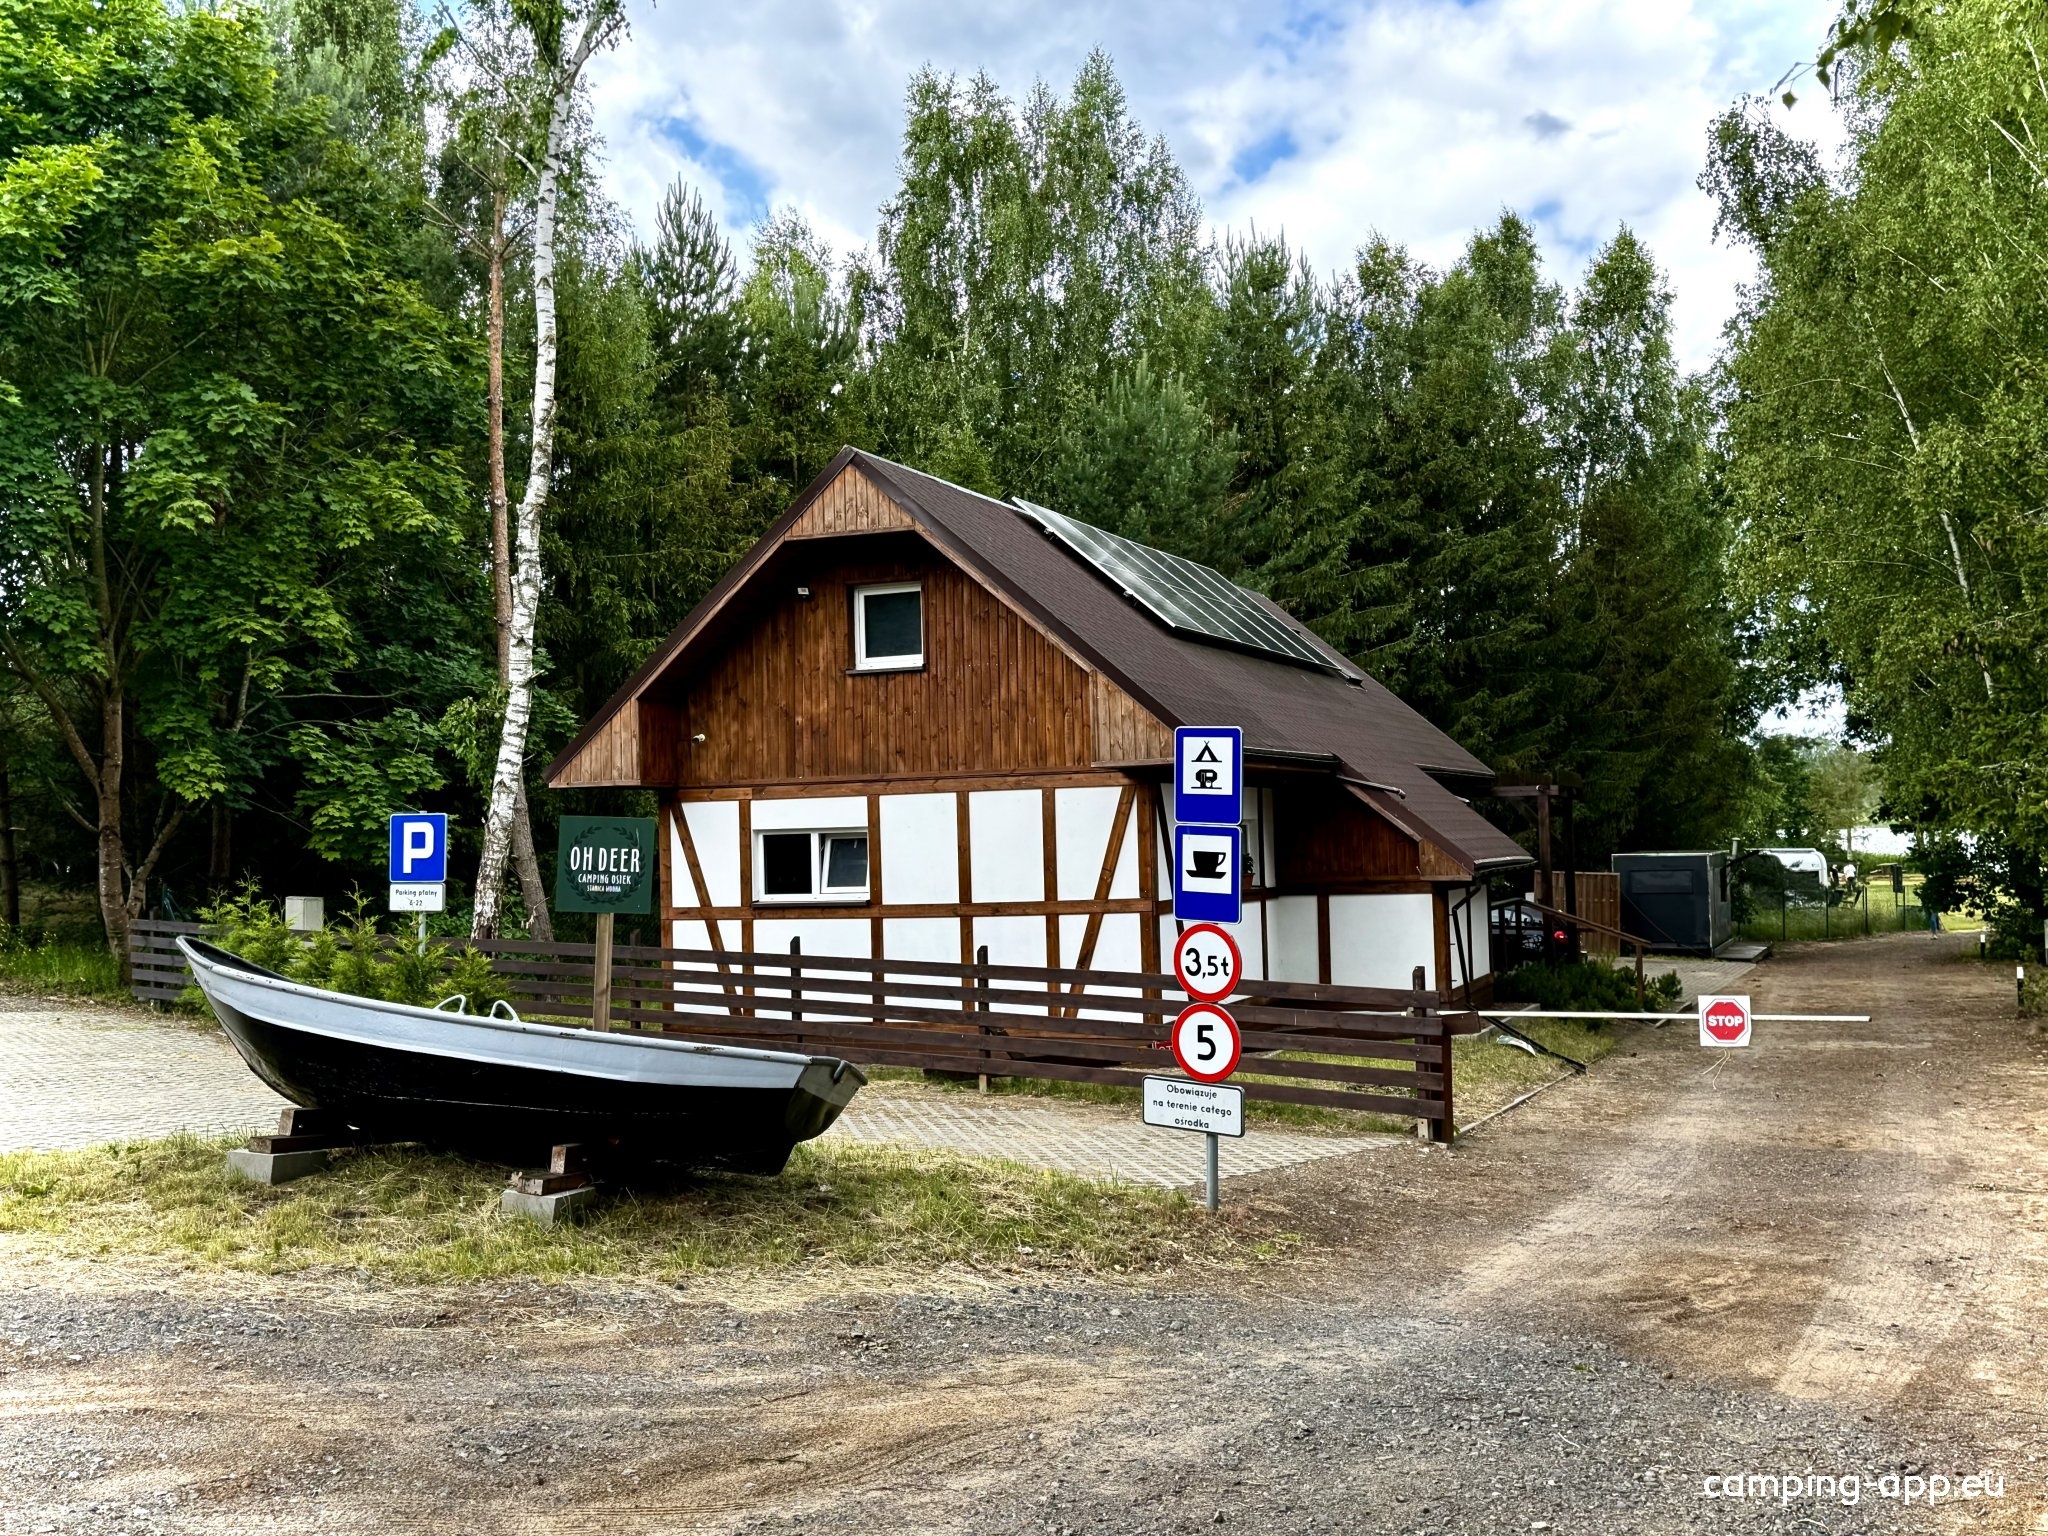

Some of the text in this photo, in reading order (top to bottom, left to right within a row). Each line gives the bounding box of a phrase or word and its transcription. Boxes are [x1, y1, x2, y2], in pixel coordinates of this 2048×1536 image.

[403, 822, 434, 873] P
[570, 846, 640, 872] OH DEER
[578, 873, 632, 885] CAMPING OSIEK
[395, 889, 417, 897] Parking
[1708, 1015, 1743, 1027] STOP
[1197, 1025, 1217, 1061] 5
[1166, 1084, 1218, 1100] Obowiązuje
[1166, 1100, 1198, 1112] terenie
[1200, 1105, 1232, 1118] całego
[1174, 1117, 1210, 1129] ośrodka
